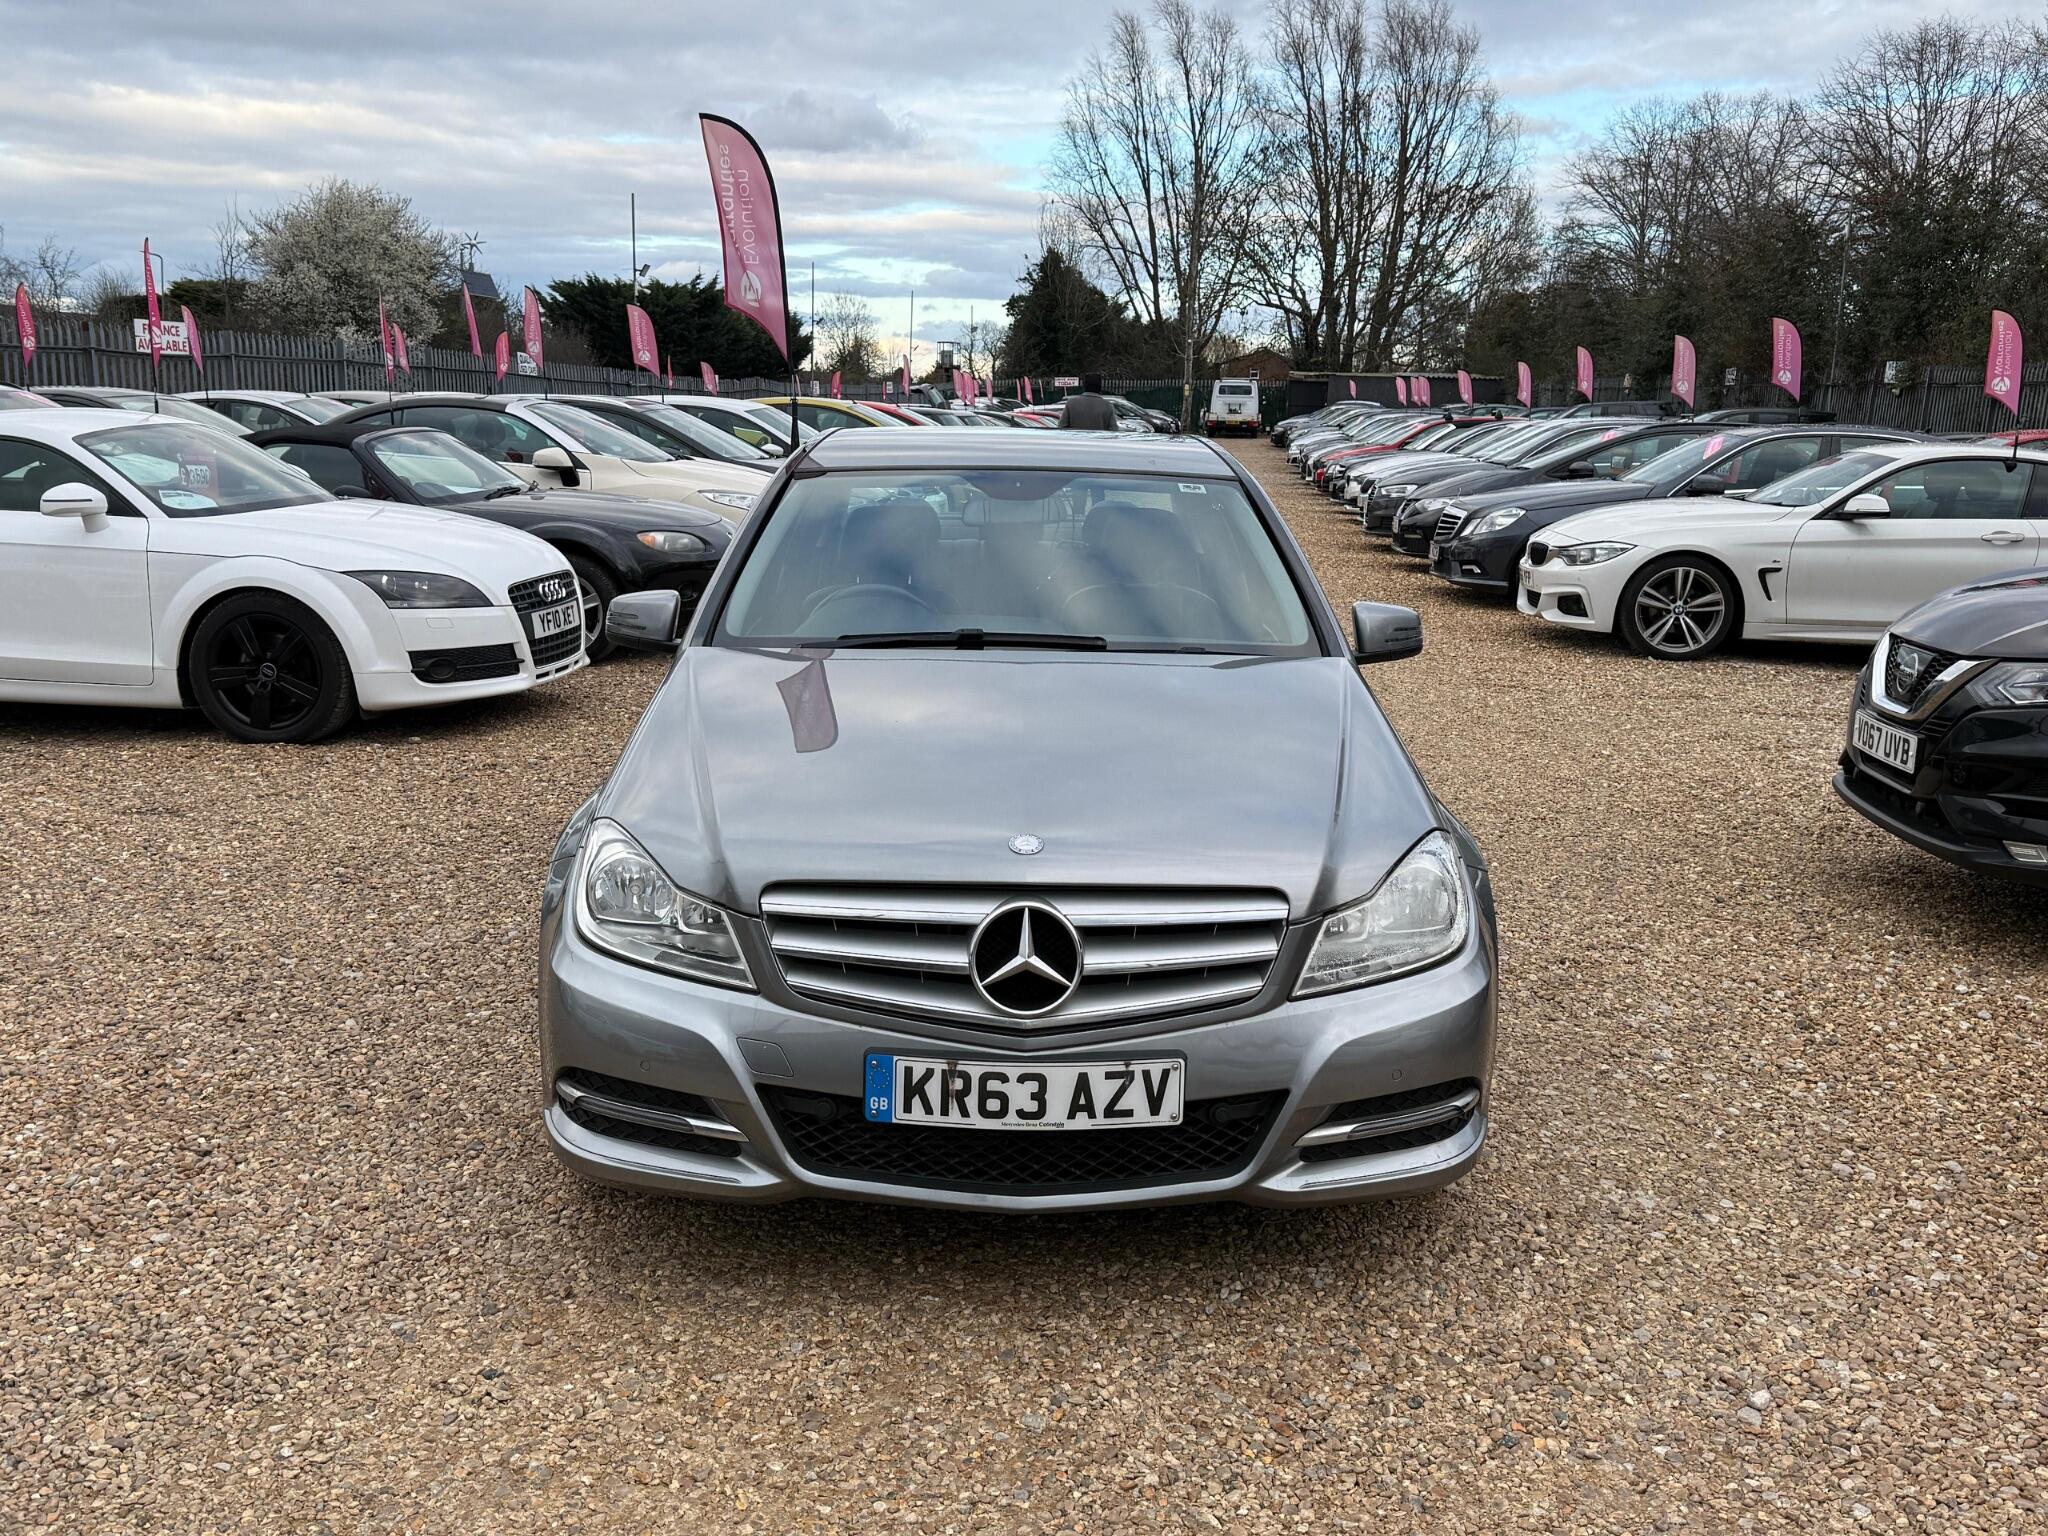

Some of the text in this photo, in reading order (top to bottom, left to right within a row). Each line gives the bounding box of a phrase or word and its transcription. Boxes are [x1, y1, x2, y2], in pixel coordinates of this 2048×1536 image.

[538, 605, 576, 632] YF10 XET
[1857, 716, 1911, 766] VO67 UVB
[870, 1096, 889, 1110] GB
[902, 1065, 1172, 1121] KR63 AZV
